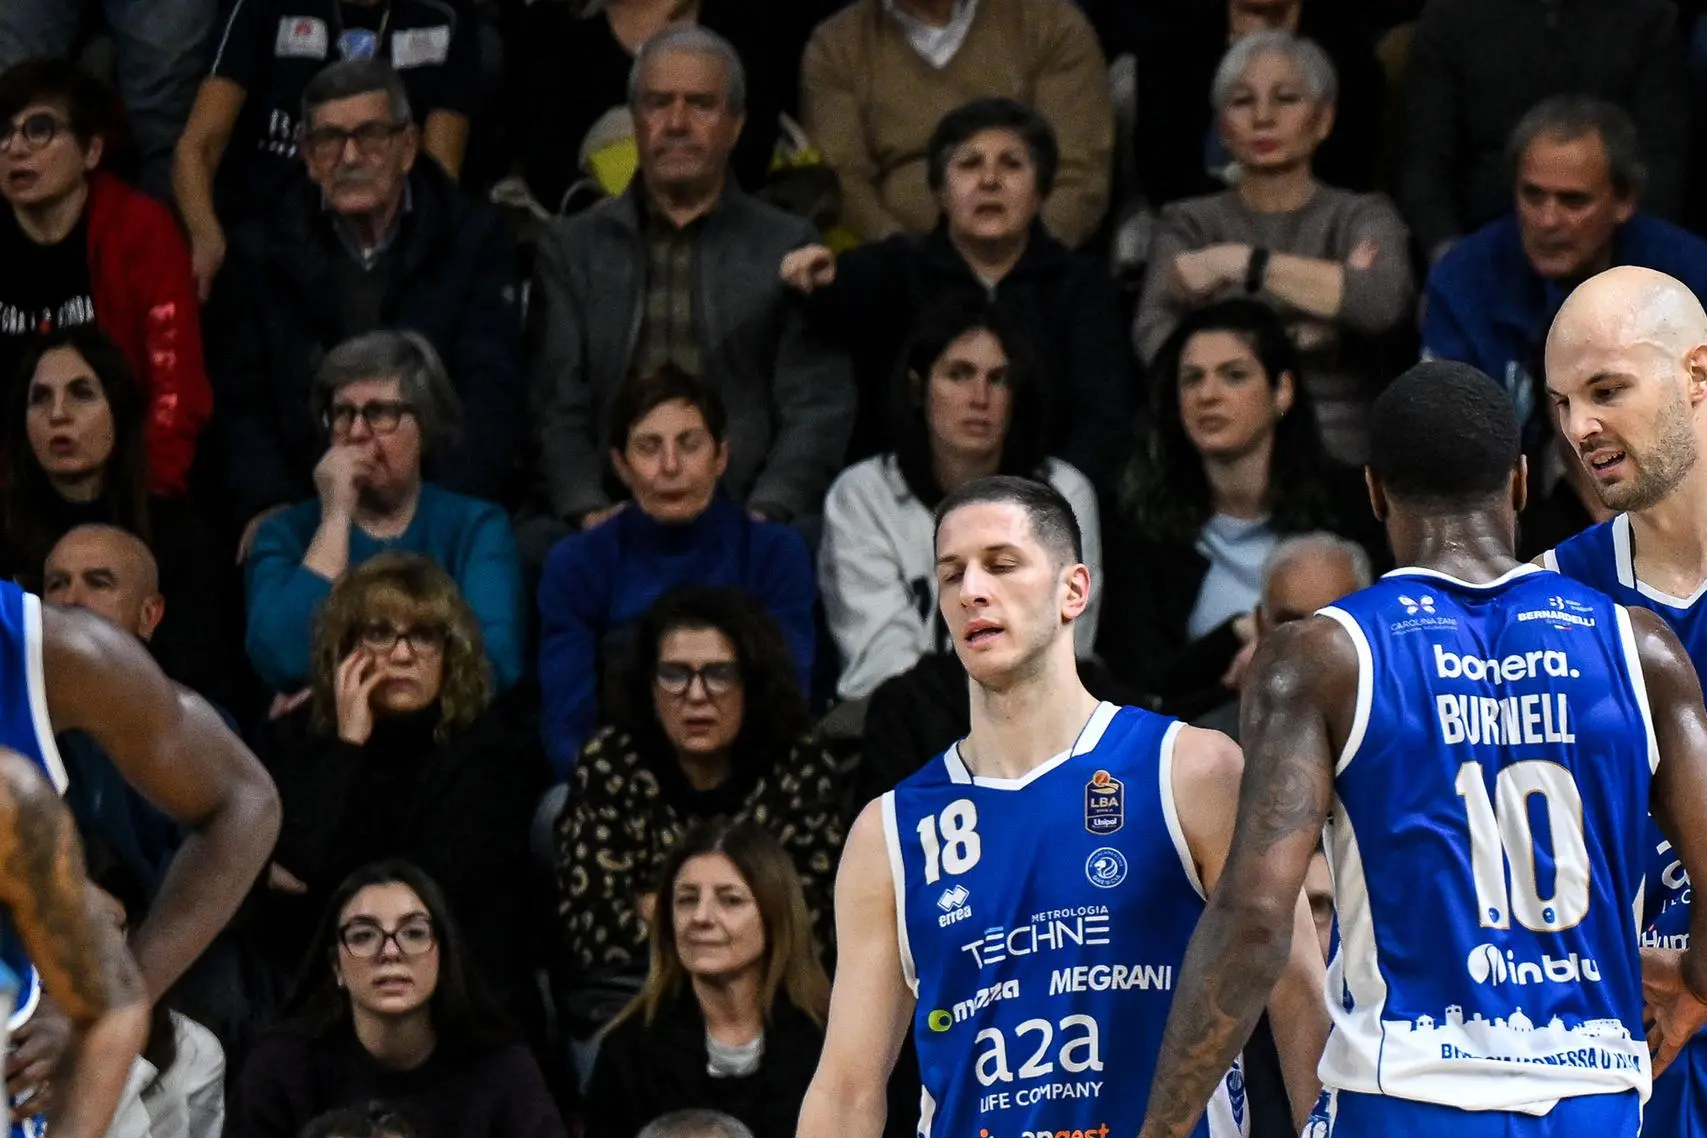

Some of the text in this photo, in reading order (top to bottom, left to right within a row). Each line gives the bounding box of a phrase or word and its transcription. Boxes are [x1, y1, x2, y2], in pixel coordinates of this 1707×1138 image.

[1517, 610, 1596, 627] BERNARDELLI
[1436, 693, 1576, 746] BURNELL
[1090, 796, 1119, 808] LBA
[1093, 818, 1118, 828] Unipol
[916, 798, 982, 886] 18
[1455, 759, 1592, 932] 10
[1032, 904, 1109, 922] METROLOGIA
[1049, 964, 1172, 996] MEGRANI
[1507, 949, 1602, 985] inblu
[974, 1013, 1104, 1087] a2a
[980, 1081, 1104, 1113] LIFE COMPANY
